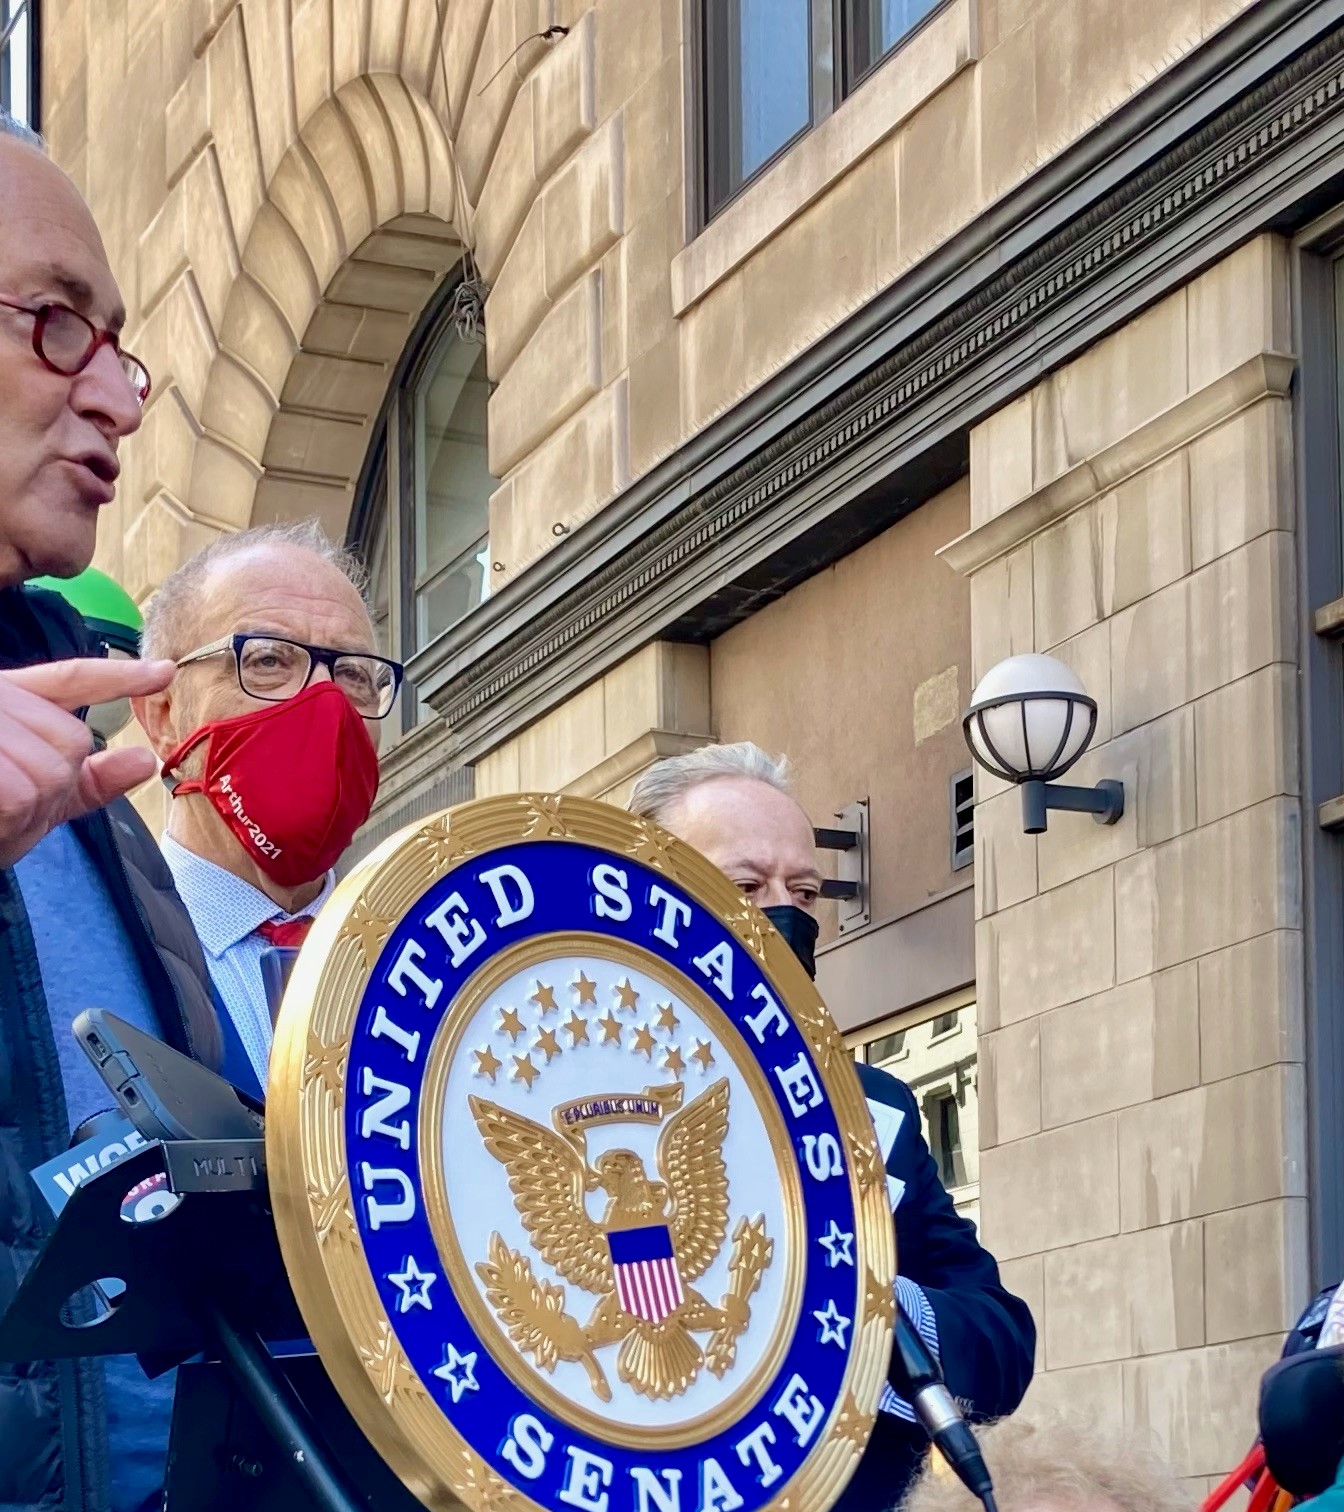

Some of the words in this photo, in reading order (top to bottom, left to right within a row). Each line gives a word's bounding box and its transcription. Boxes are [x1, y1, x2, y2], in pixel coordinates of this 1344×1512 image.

[219, 774, 283, 860] Arthur2021
[360, 864, 535, 1231] UNITED
[592, 863, 843, 1182] STATES
